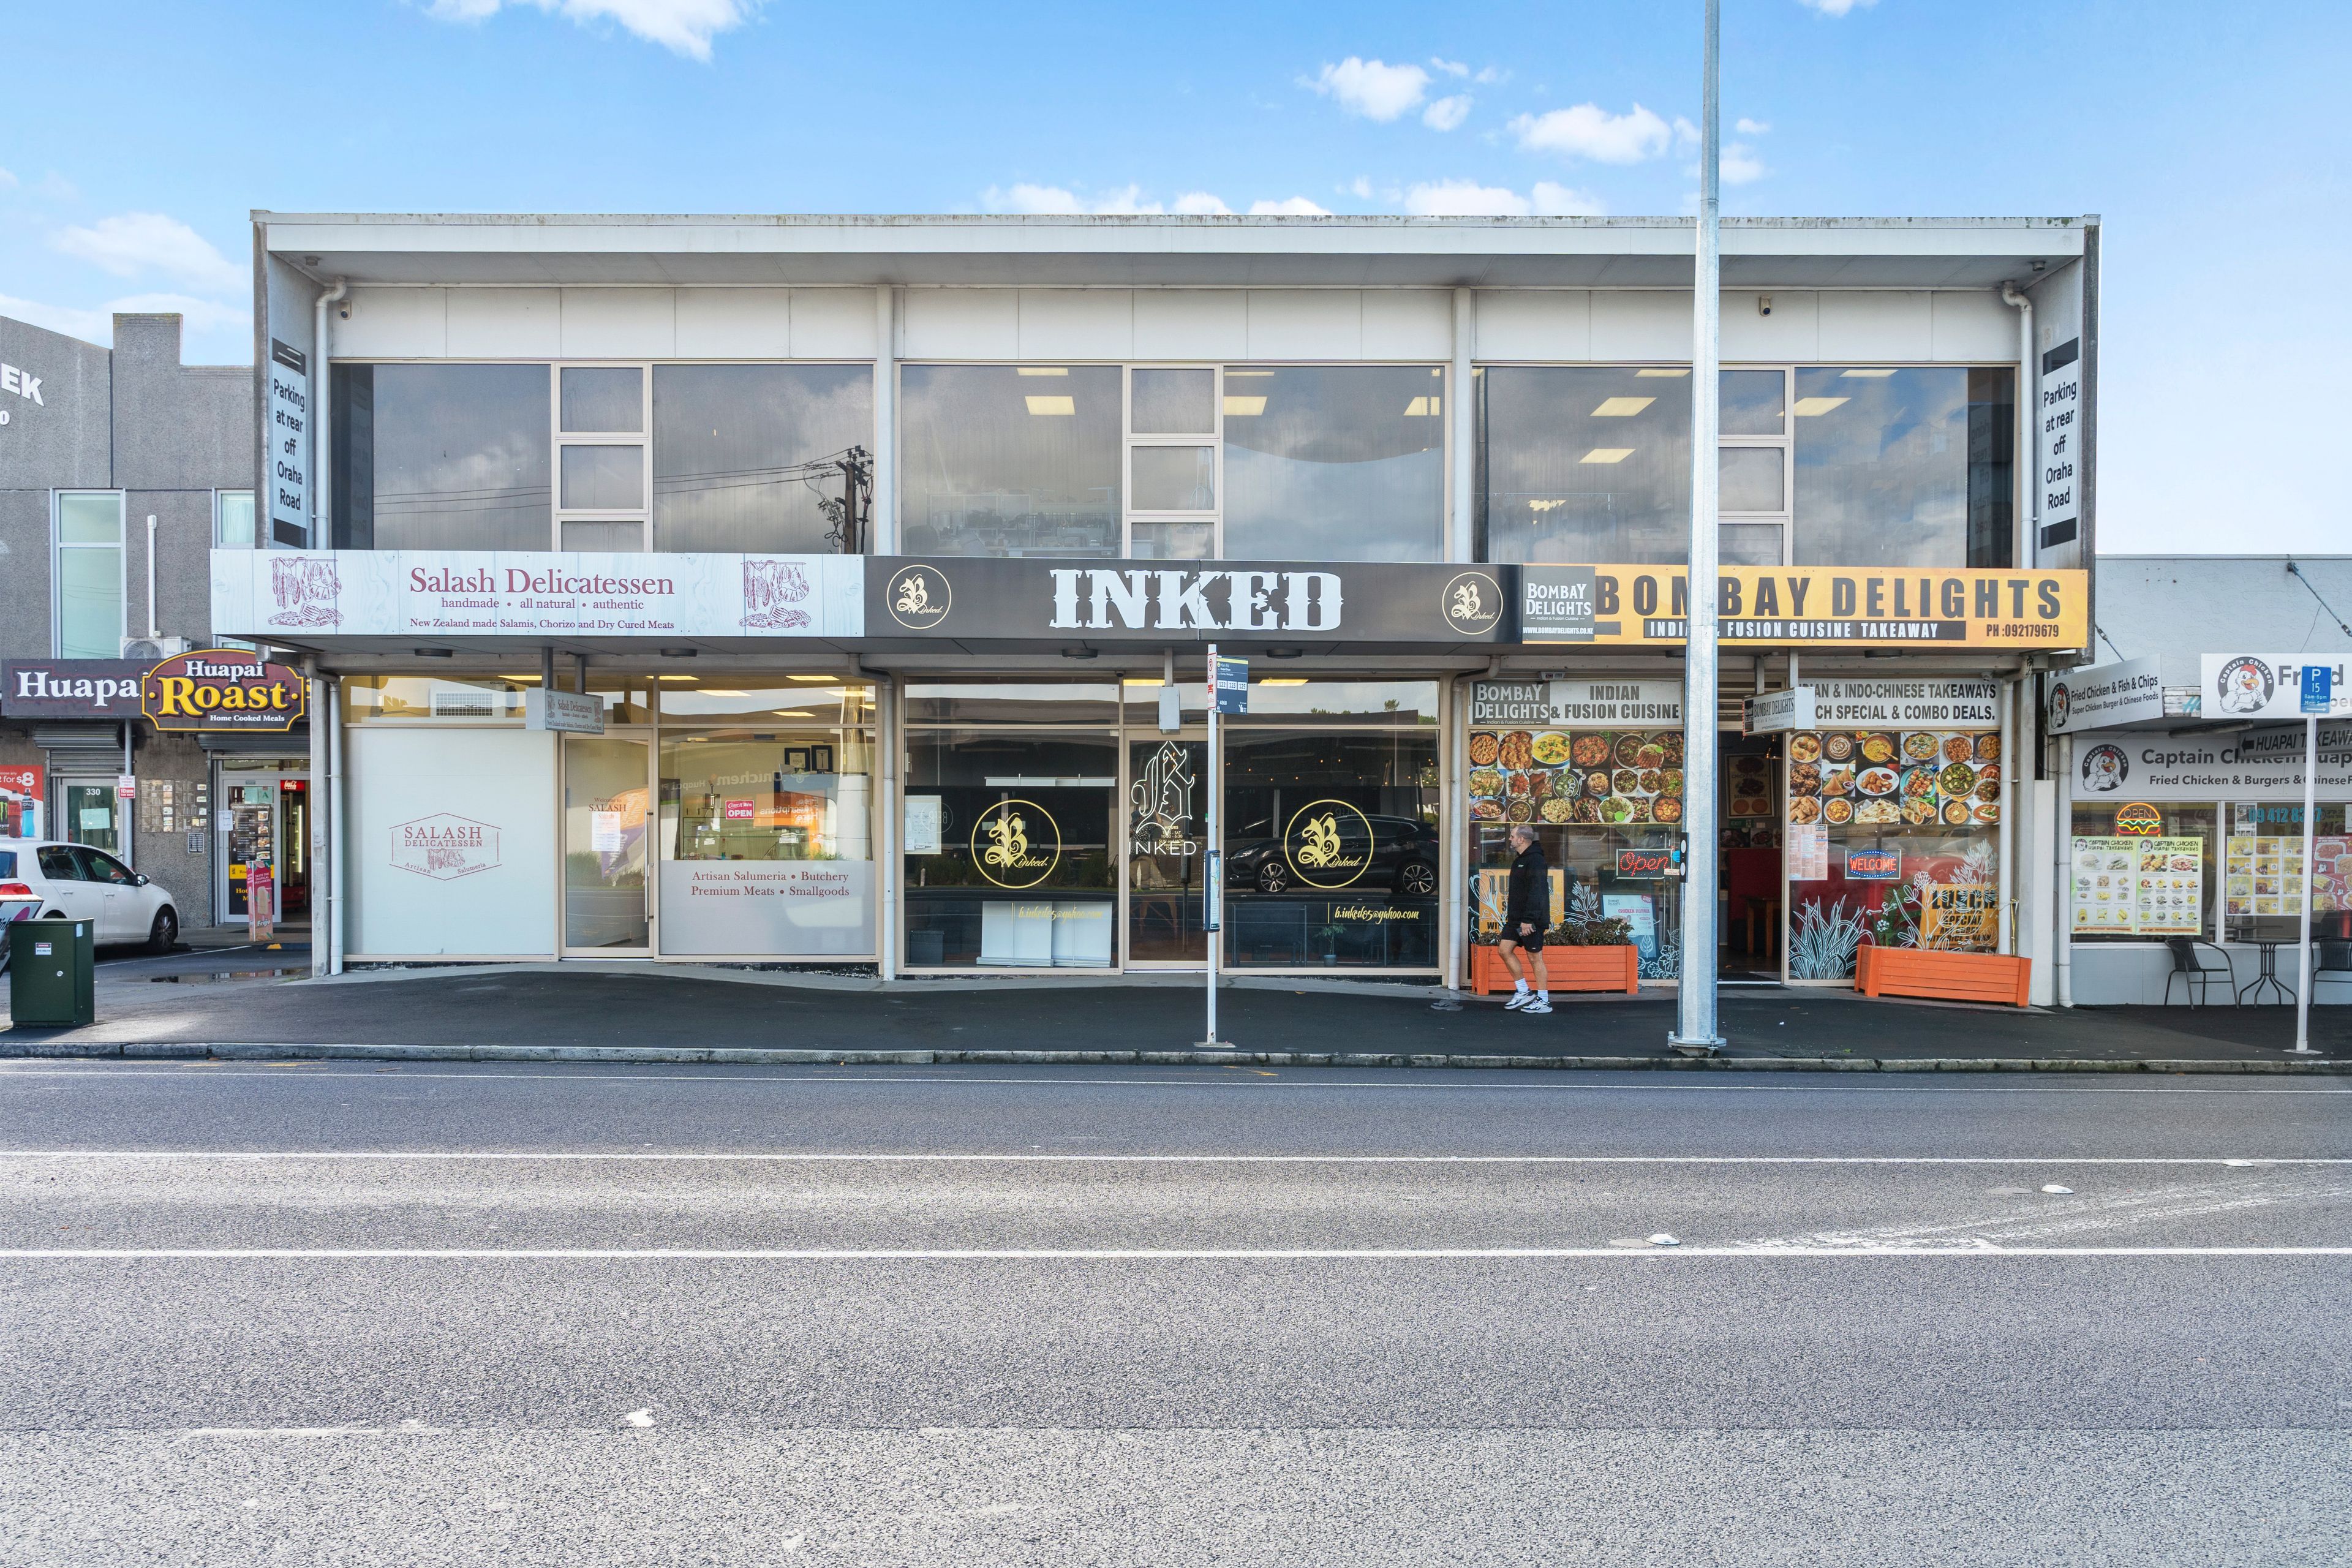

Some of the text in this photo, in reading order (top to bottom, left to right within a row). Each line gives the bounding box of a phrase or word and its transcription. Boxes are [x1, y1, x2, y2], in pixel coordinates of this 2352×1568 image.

[273, 378, 305, 412] Parking
[2044, 382, 2076, 407] Parking
[276, 409, 303, 433] at rear
[2046, 409, 2074, 432] at rear
[284, 439, 296, 456] off
[2054, 435, 2065, 455] off
[277, 461, 303, 485] Oraha
[2046, 462, 2072, 484] Oraha
[280, 488, 301, 511] Road
[2048, 487, 2070, 510] Road
[410, 567, 674, 595] Salash Delicatessen
[1049, 568, 1344, 631] INKED
[1527, 583, 1587, 599] BOMBAY
[1833, 578, 2060, 619] DELIGHTS
[441, 598, 644, 609] handmade all natural authentic
[1526, 599, 1592, 616] DELIGHTS
[410, 619, 674, 630] New Zealand made Salamis, Chorizo and Dry Cured Meats
[1523, 627, 1593, 635] WWW.BOMBAYDELIGHTS.CO.NZ
[1650, 621, 1938, 638] INDI FUSION CUISINE TAKEAWAY
[1986, 624, 1999, 636] PH
[186, 661, 264, 682] Huapai
[2220, 659, 2272, 684] Captain Chicken
[2278, 664, 2343, 686] Frd
[2312, 669, 2321, 681] P
[17, 671, 148, 707] Huapa
[157, 676, 289, 716] Roast
[1477, 684, 1544, 701] BOMBAY
[1590, 685, 1640, 701] INDIAN
[1833, 684, 1841, 698] &
[1845, 684, 1924, 698] INDO-CHINESE
[1928, 684, 1996, 699] TAKEAWAYS
[2071, 674, 2158, 703] Fried Chicken & Fish & Chips
[2312, 683, 2320, 693] 15
[1475, 702, 1550, 719] DELIGHTS
[1550, 704, 1679, 719] & FUSION CUISINE
[1754, 701, 1771, 717] BOMBAY
[1772, 698, 1794, 714] DELIGHTS
[2072, 704, 2084, 715] Super
[2085, 702, 2102, 712] Chicken
[2103, 699, 2118, 710] Burger
[2124, 695, 2142, 704] Chinese
[2143, 692, 2158, 701] Foods
[1836, 705, 1887, 720] SPECIAL
[1891, 706, 1900, 720] &
[1904, 705, 1948, 720] COMBO
[1953, 706, 1995, 720] DEALS.
[2256, 734, 2296, 751] HUAPAI
[2084, 746, 2128, 767] Captain Chicken
[2142, 748, 2214, 768] Captain
[17, 772, 35, 787] $8
[2149, 775, 2301, 787] Fried Chicken & Burgers &
[2124, 809, 2152, 818] OPEN
[2248, 808, 2321, 823] 09 412 837
[405, 826, 481, 839] SALASH
[1129, 842, 1196, 855] INKED
[405, 862, 486, 874] Artisan Salumeria
[1620, 852, 1670, 876] Open
[1850, 858, 1896, 871] WELCOME
[692, 871, 849, 883] Artisan Salumeria Butchery
[691, 886, 849, 898] Premium Meats Smallgoods
